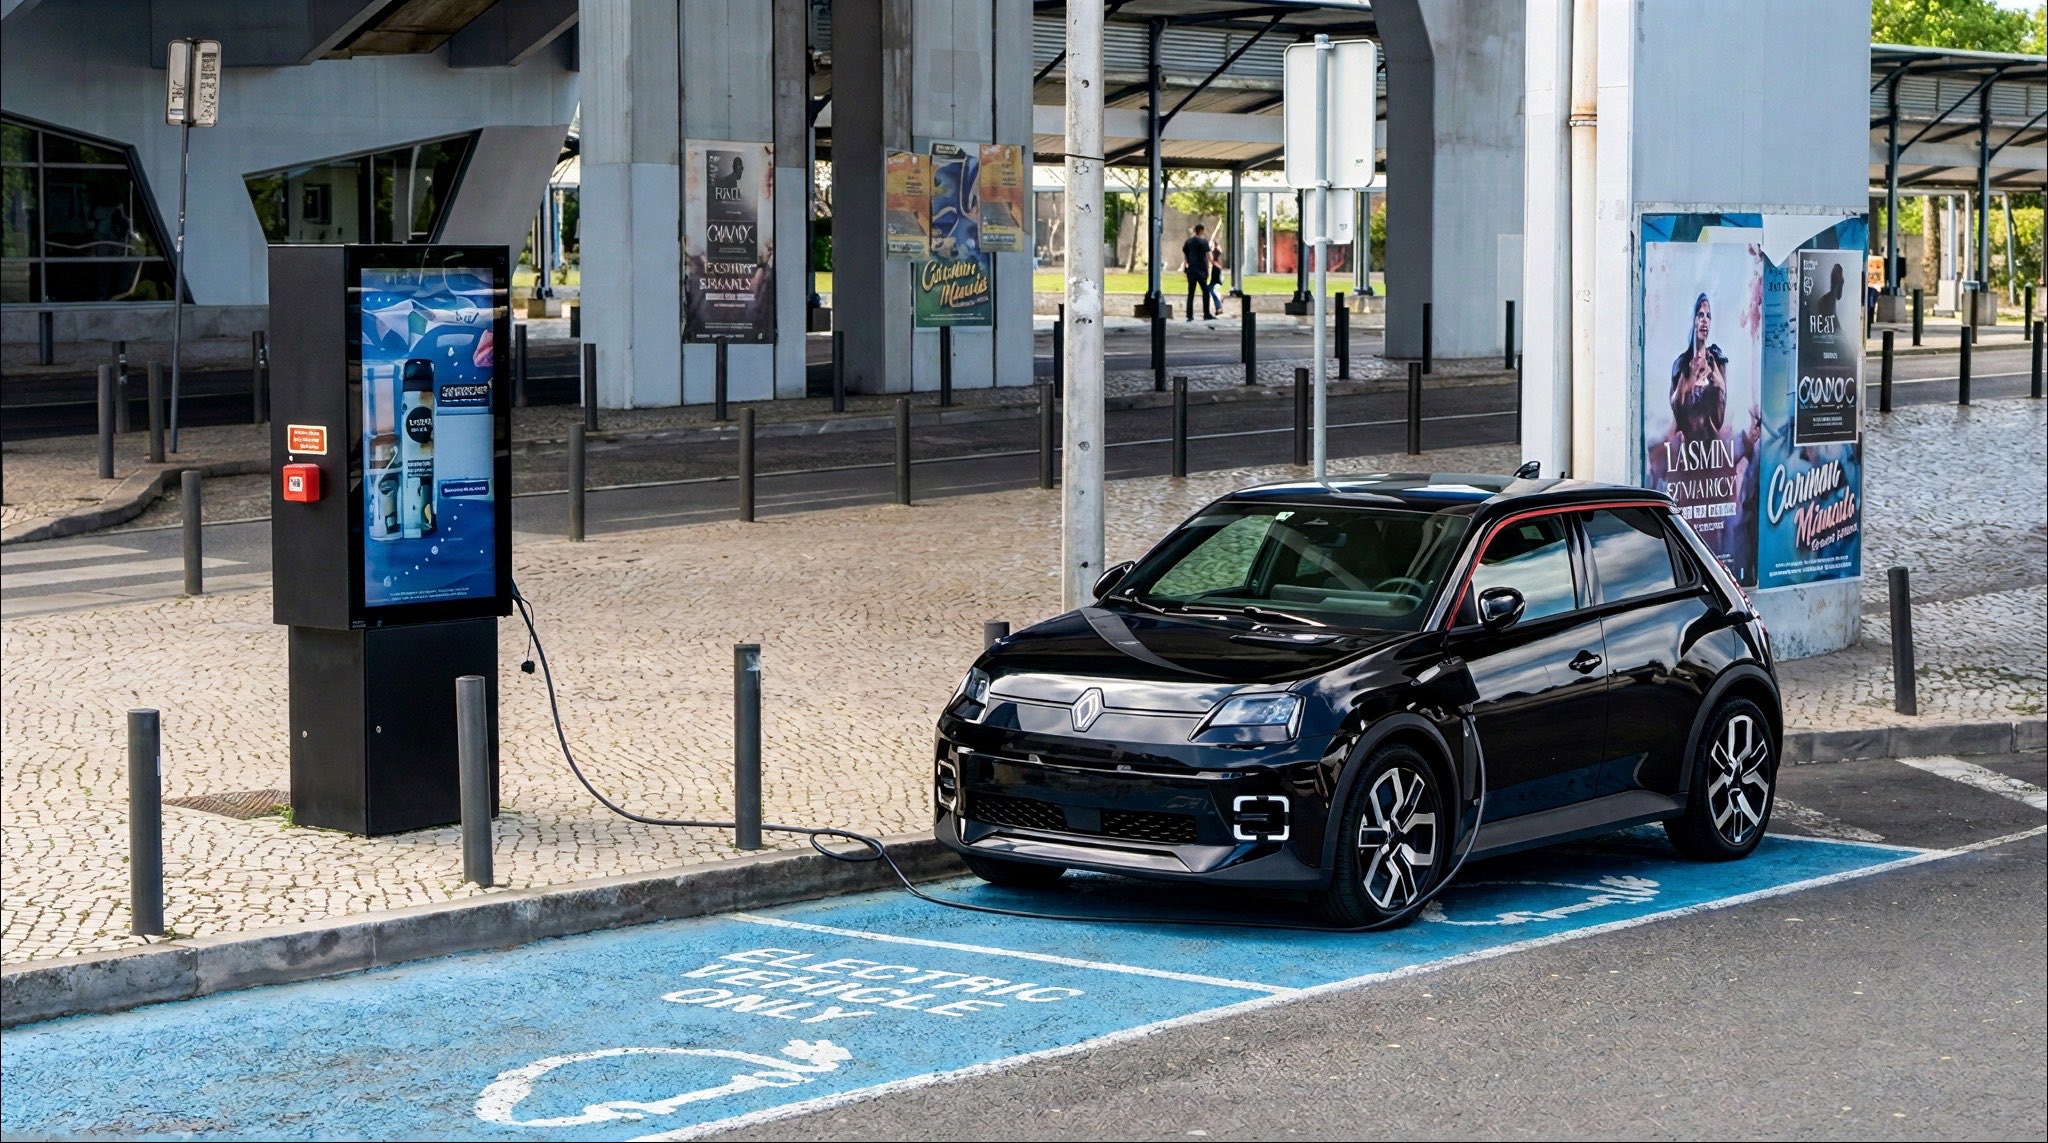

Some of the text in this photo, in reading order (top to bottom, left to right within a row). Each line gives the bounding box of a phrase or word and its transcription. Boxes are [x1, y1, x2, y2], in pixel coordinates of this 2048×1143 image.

[681, 964, 1007, 1017] VEHICLE
[719, 947, 1086, 1002] ELECTRIC
[661, 987, 878, 1024] ONLY
